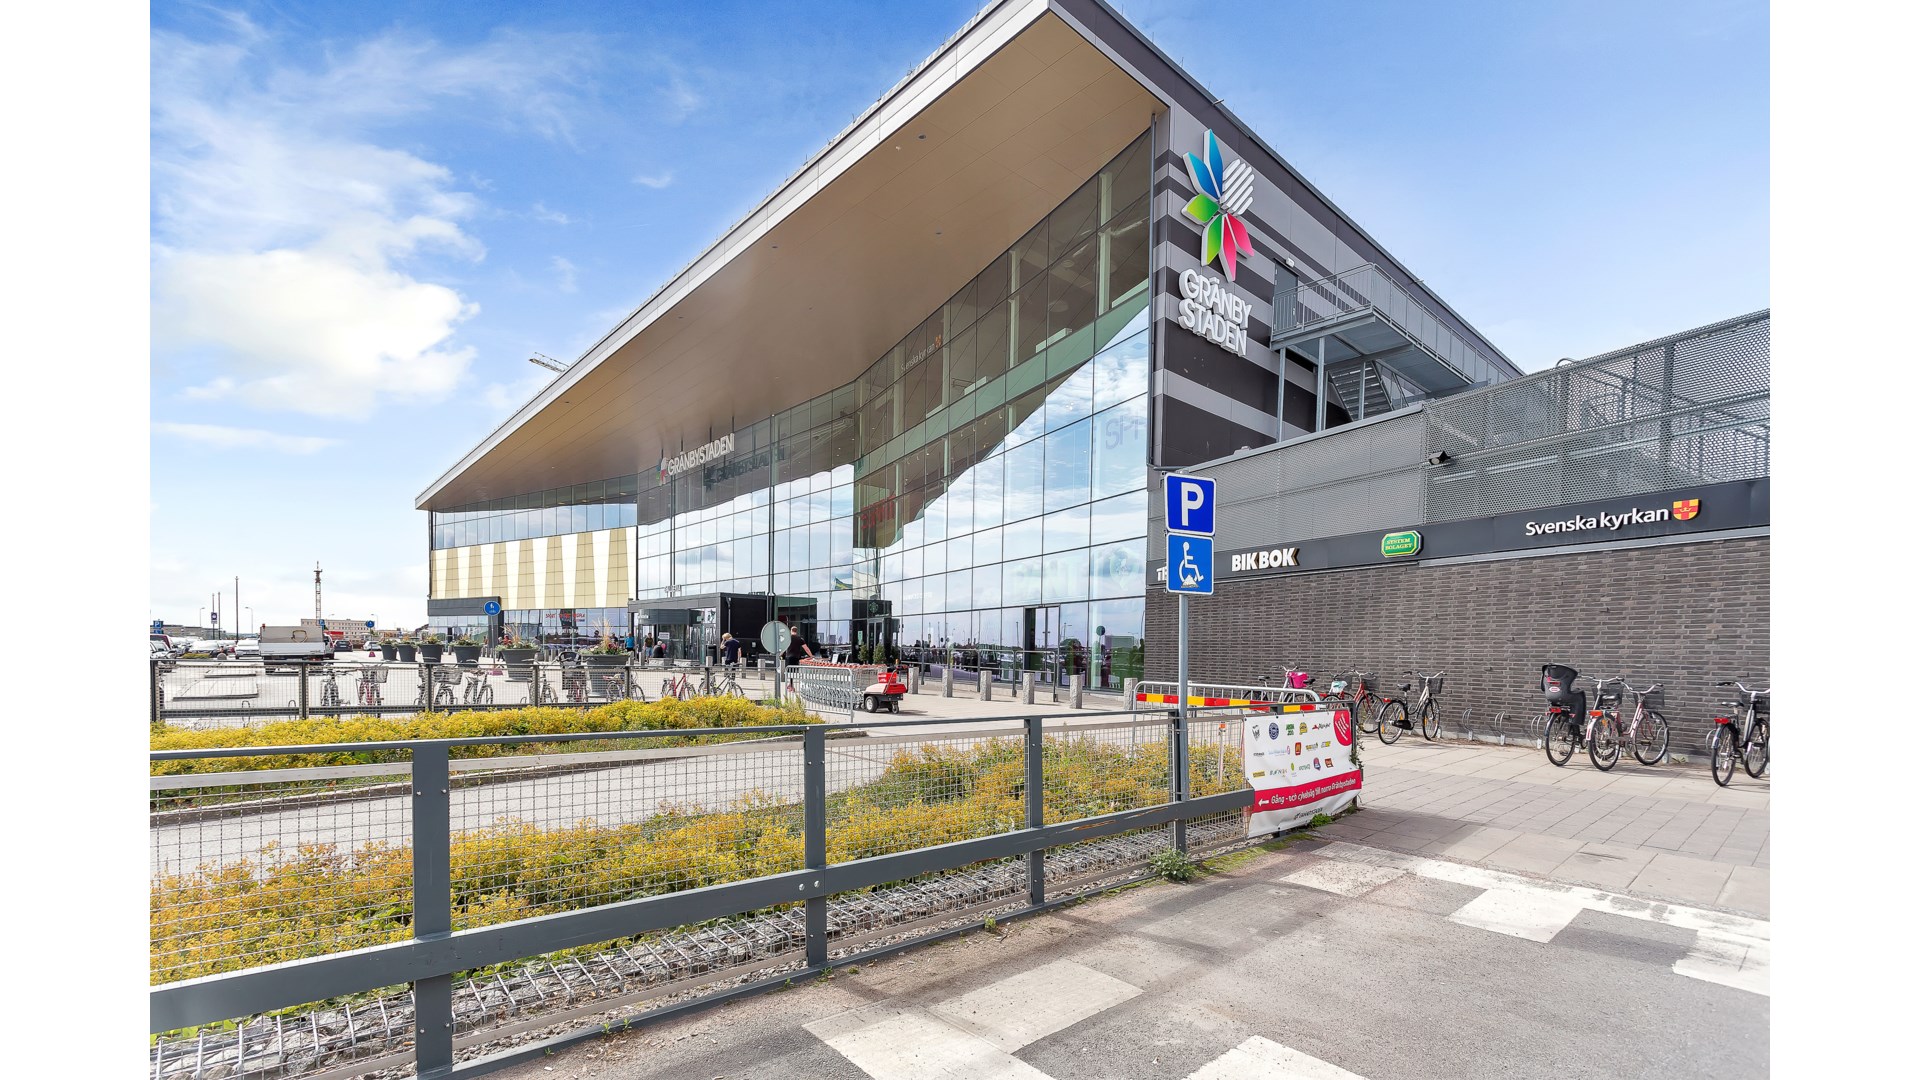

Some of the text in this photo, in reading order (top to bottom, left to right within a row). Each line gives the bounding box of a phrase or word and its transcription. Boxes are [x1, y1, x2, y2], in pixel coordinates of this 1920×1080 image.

[1178, 298, 1248, 358] STADEN
[1180, 481, 1205, 527] P
[1525, 506, 1669, 537] Svenska kyrkan
[1385, 543, 1413, 551] BOLAGET
[1386, 537, 1411, 546] SYSTEM
[1271, 793, 1285, 805] Gång
